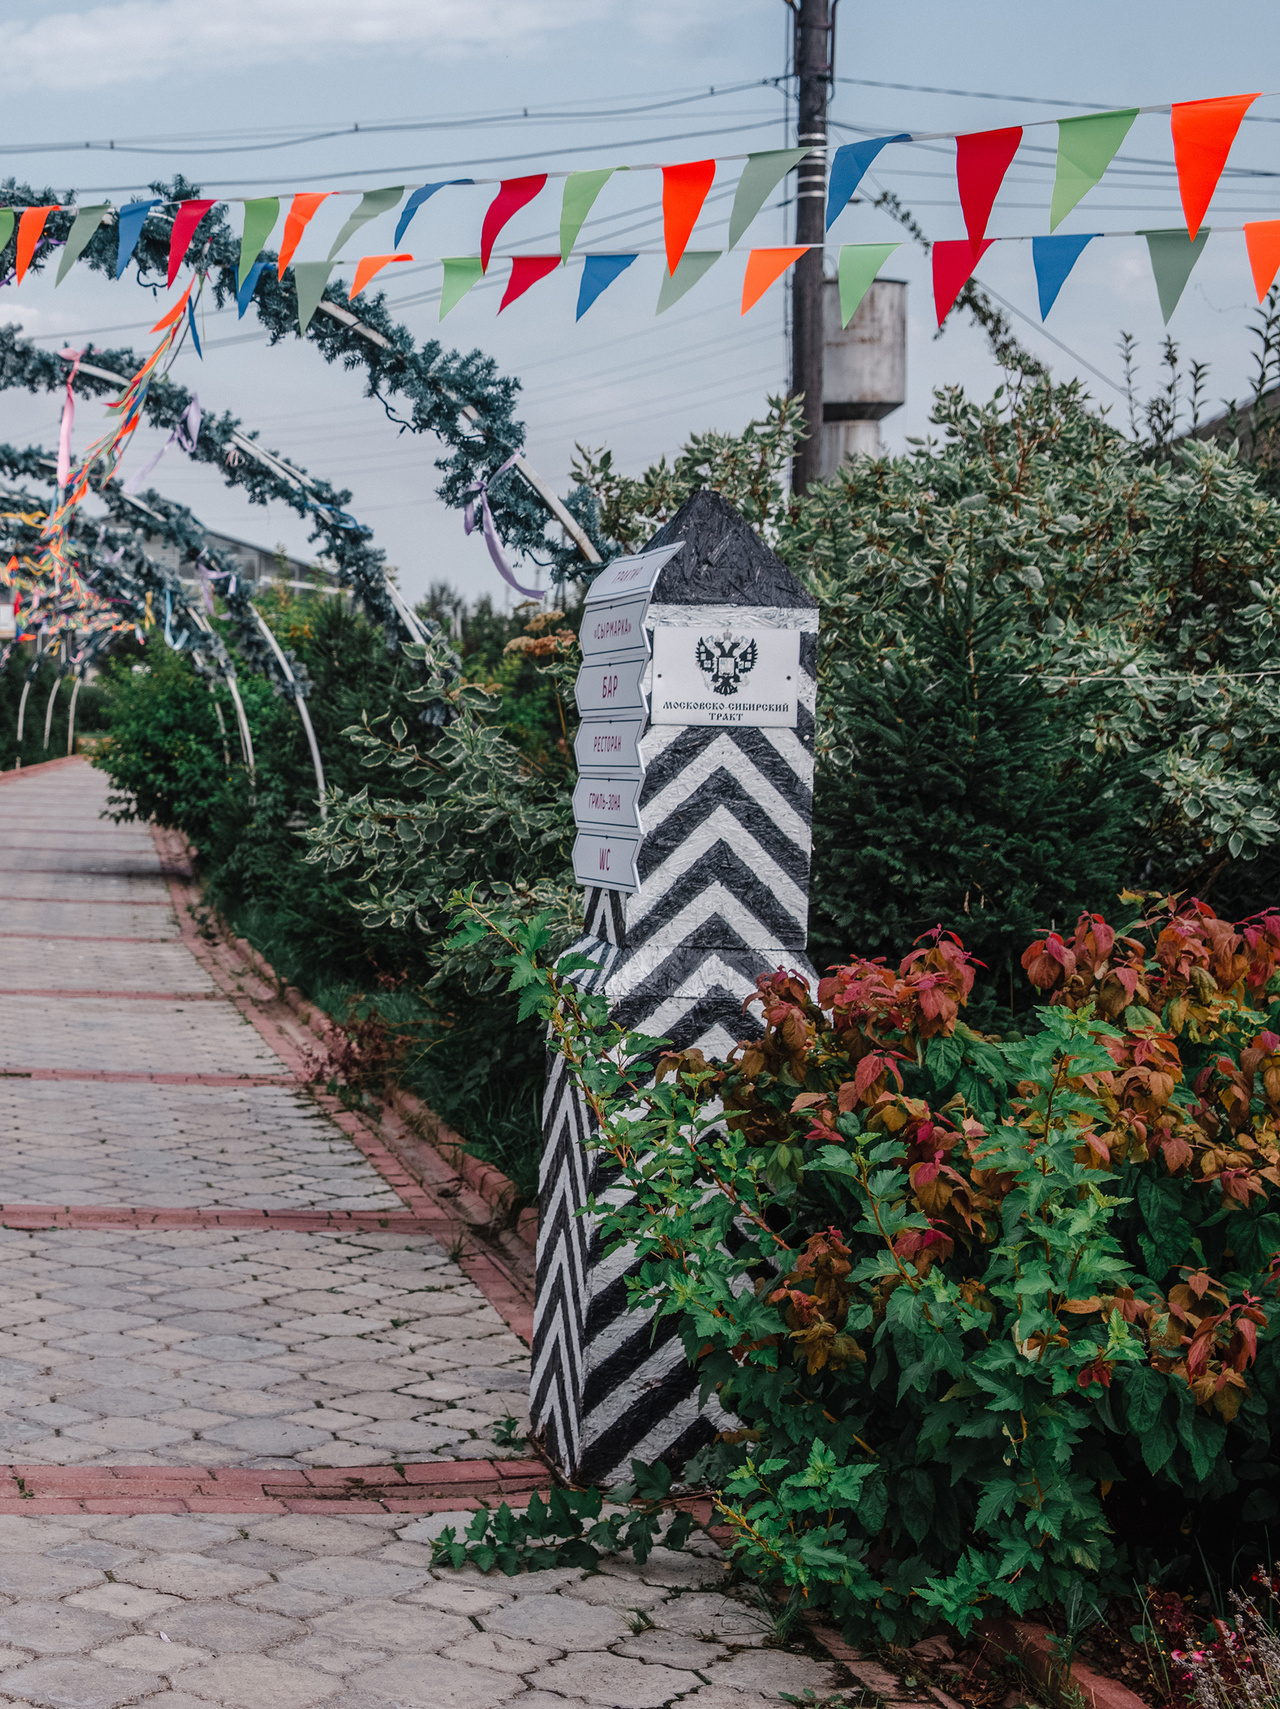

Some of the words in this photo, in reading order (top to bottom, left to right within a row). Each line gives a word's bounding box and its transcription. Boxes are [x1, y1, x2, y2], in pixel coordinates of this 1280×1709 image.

[602, 675, 619, 698] БАР
[663, 701, 789, 712] МОСКОВСКО-СИБИРСКИЙ
[708, 713, 744, 721] ТРАКТ
[593, 735, 622, 752] РЕСТОРАН
[588, 792, 621, 811] ГРИЛЬ-ЗОНА
[599, 847, 611, 871] WC
